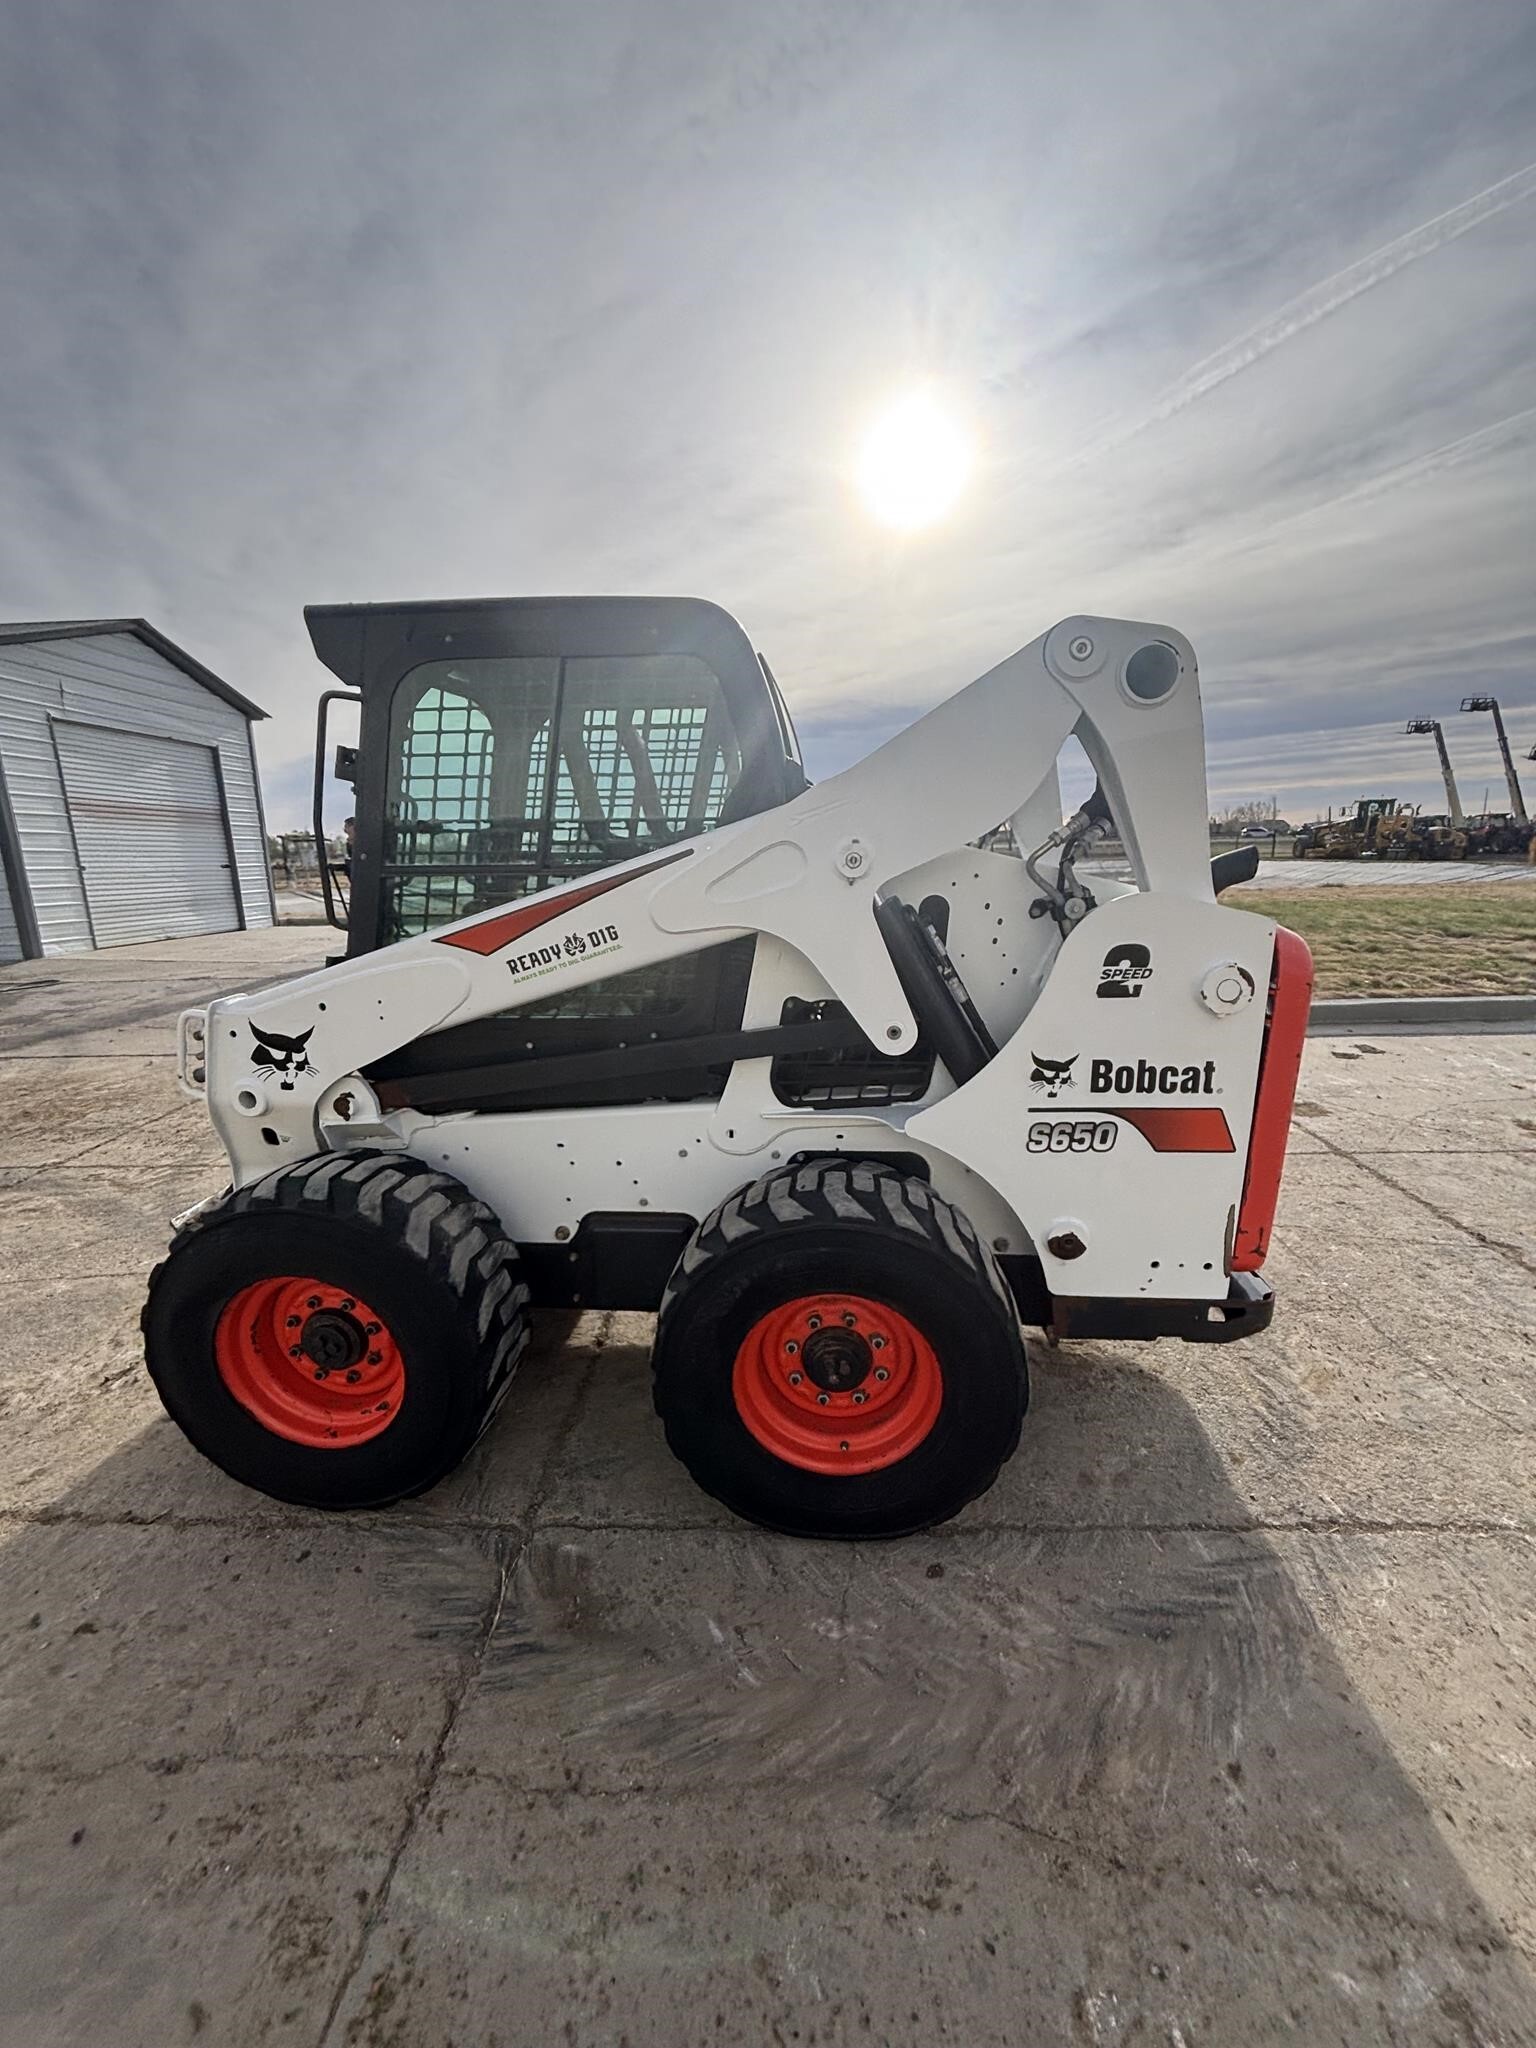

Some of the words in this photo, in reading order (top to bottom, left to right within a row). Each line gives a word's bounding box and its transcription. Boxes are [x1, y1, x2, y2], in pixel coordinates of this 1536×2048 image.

[506, 943, 561, 975] READY
[587, 925, 619, 948] DIG
[513, 971, 537, 984] ALWAYS
[538, 966, 558, 976] READY
[1096, 943, 1151, 998] 2
[1100, 968, 1153, 980] SPEED
[1090, 1059, 1215, 1094] Bobcat
[1026, 1121, 1118, 1153] S650
